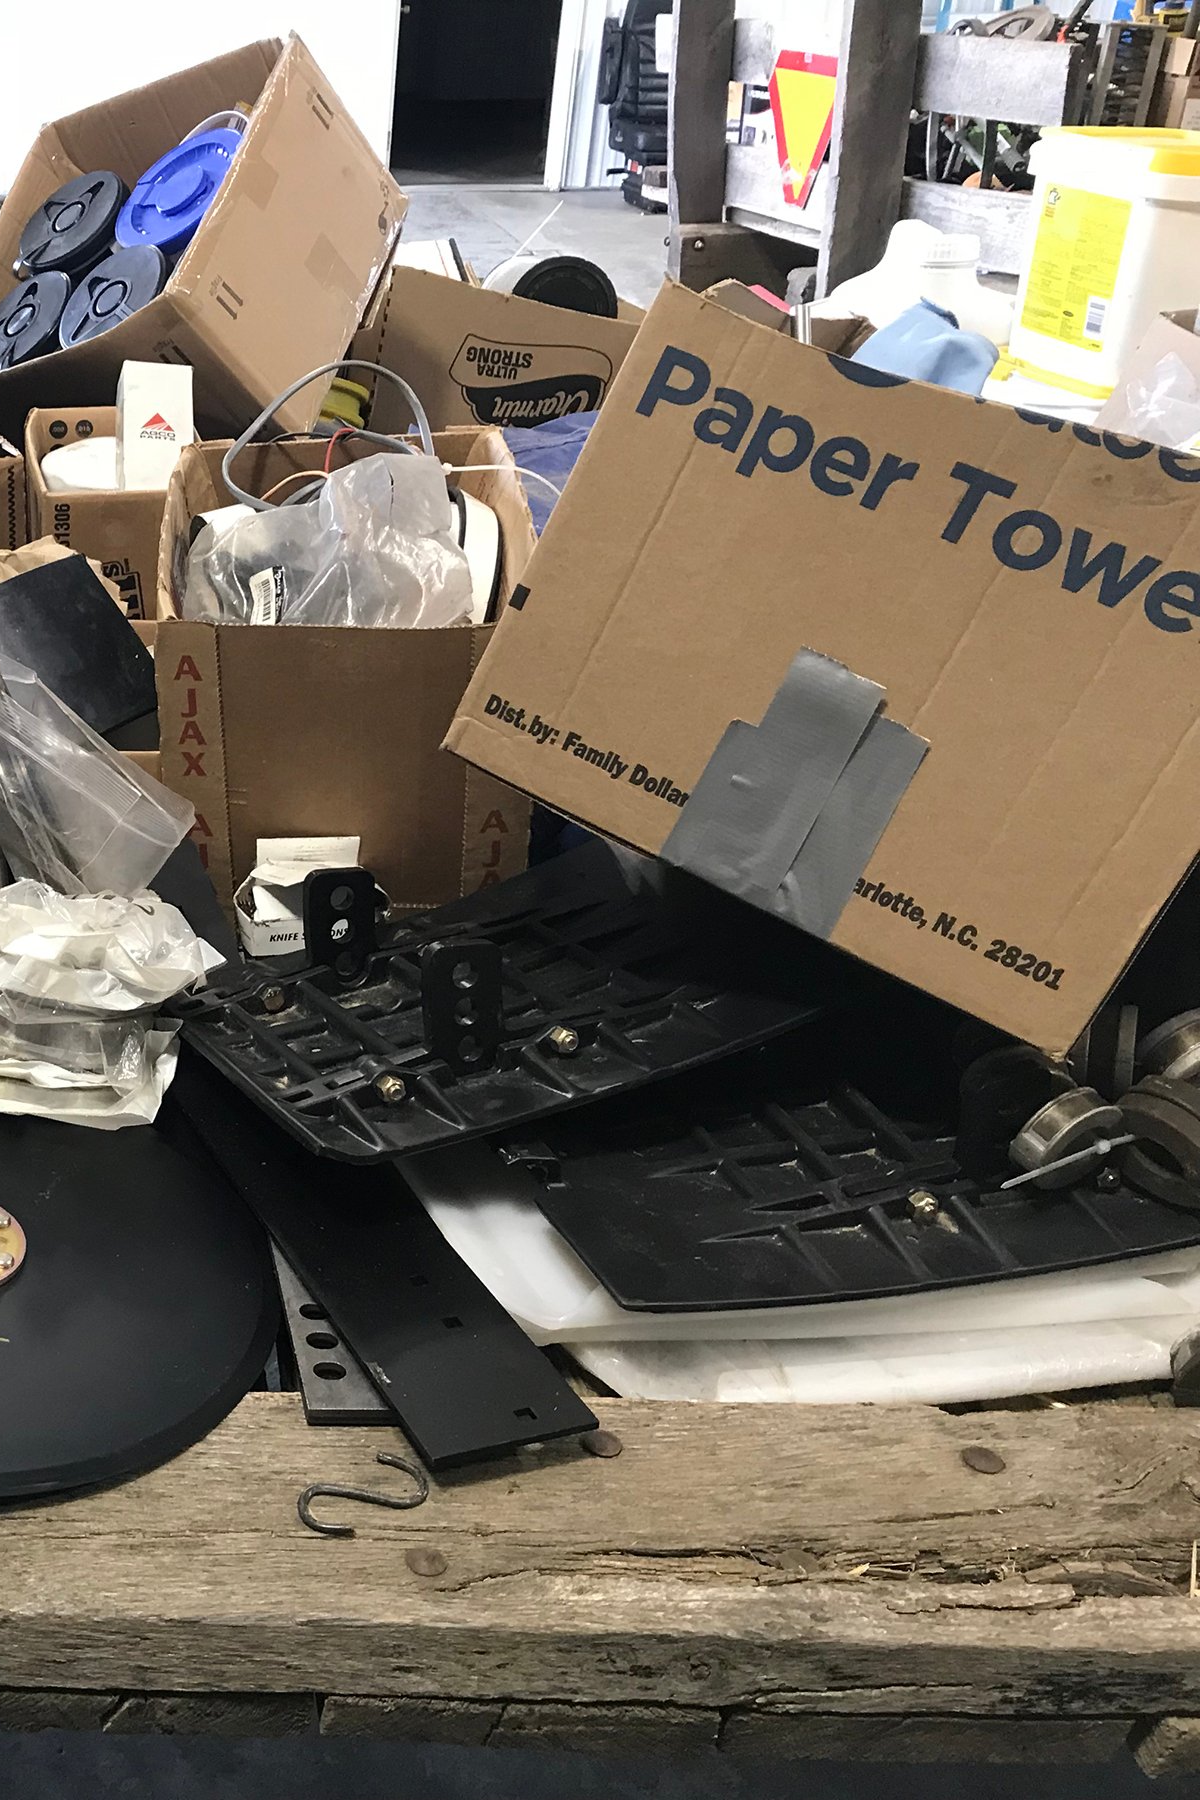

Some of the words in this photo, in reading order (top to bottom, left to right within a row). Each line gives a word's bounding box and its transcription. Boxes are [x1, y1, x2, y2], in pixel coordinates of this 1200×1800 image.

[466, 346, 534, 368] STRONG
[477, 363, 518, 380] ULTRA
[139, 434, 176, 442] PARTS
[140, 430, 176, 438] AGCO
[635, 345, 920, 511] Paper
[940, 461, 1200, 634] Towe
[173, 655, 207, 777] AJAX
[484, 693, 527, 731] Dist.
[527, 714, 560, 745] by:
[561, 731, 629, 780] Family
[628, 763, 690, 808] Dollar
[479, 809, 509, 889] AJA
[269, 932, 299, 942] KNIFE
[852, 877, 928, 930] arlotte,
[931, 911, 979, 952] N.C.
[983, 939, 1065, 991] 28201
